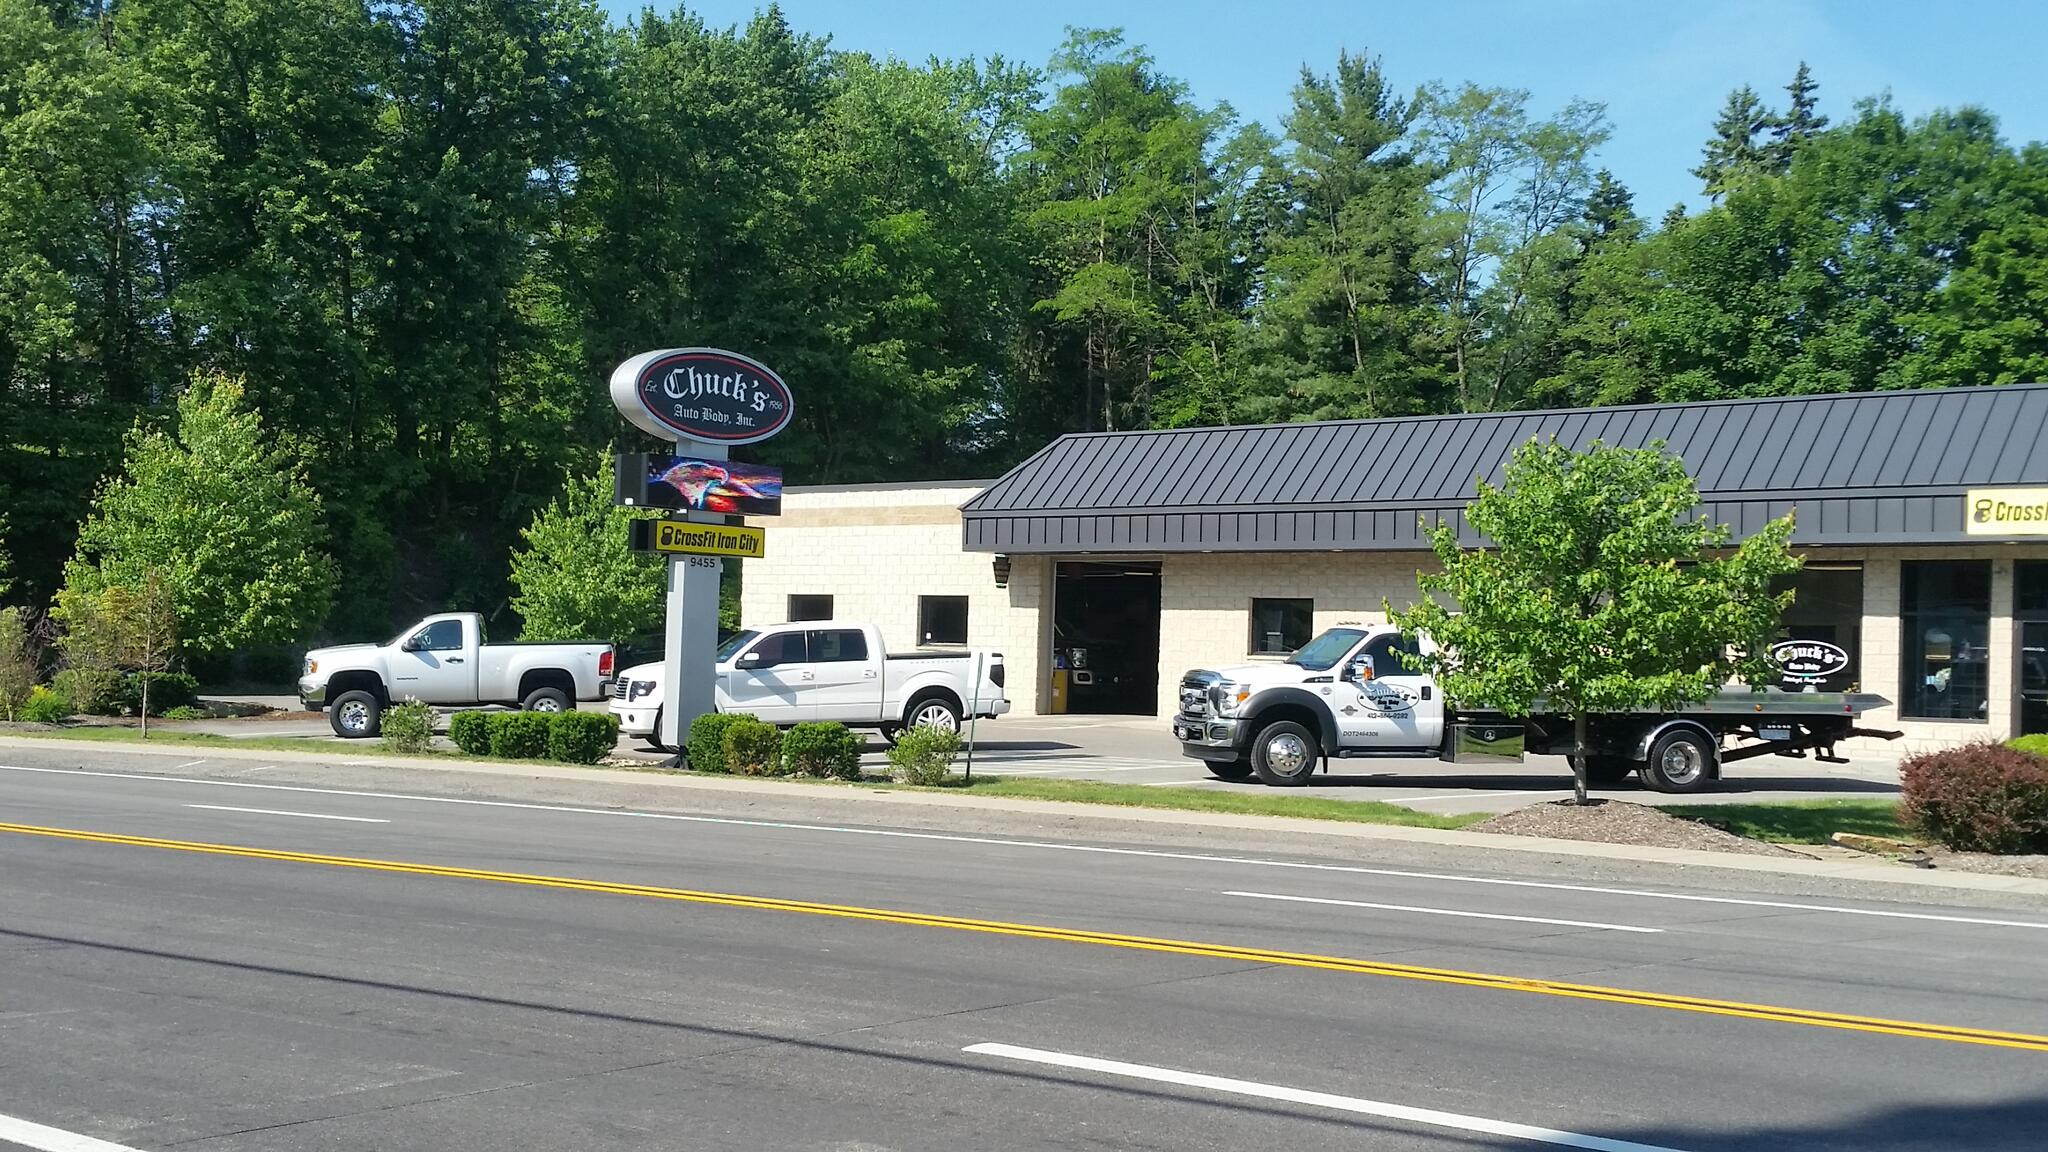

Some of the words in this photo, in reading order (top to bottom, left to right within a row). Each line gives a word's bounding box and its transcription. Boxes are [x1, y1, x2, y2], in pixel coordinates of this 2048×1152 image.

[663, 366, 770, 412] Chuck's
[673, 404, 700, 419] Auto
[735, 412, 756, 427] Inc.
[674, 529, 716, 547] CrossFit
[717, 532, 737, 549] Iron
[739, 534, 759, 553] City
[690, 557, 715, 568] 9455
